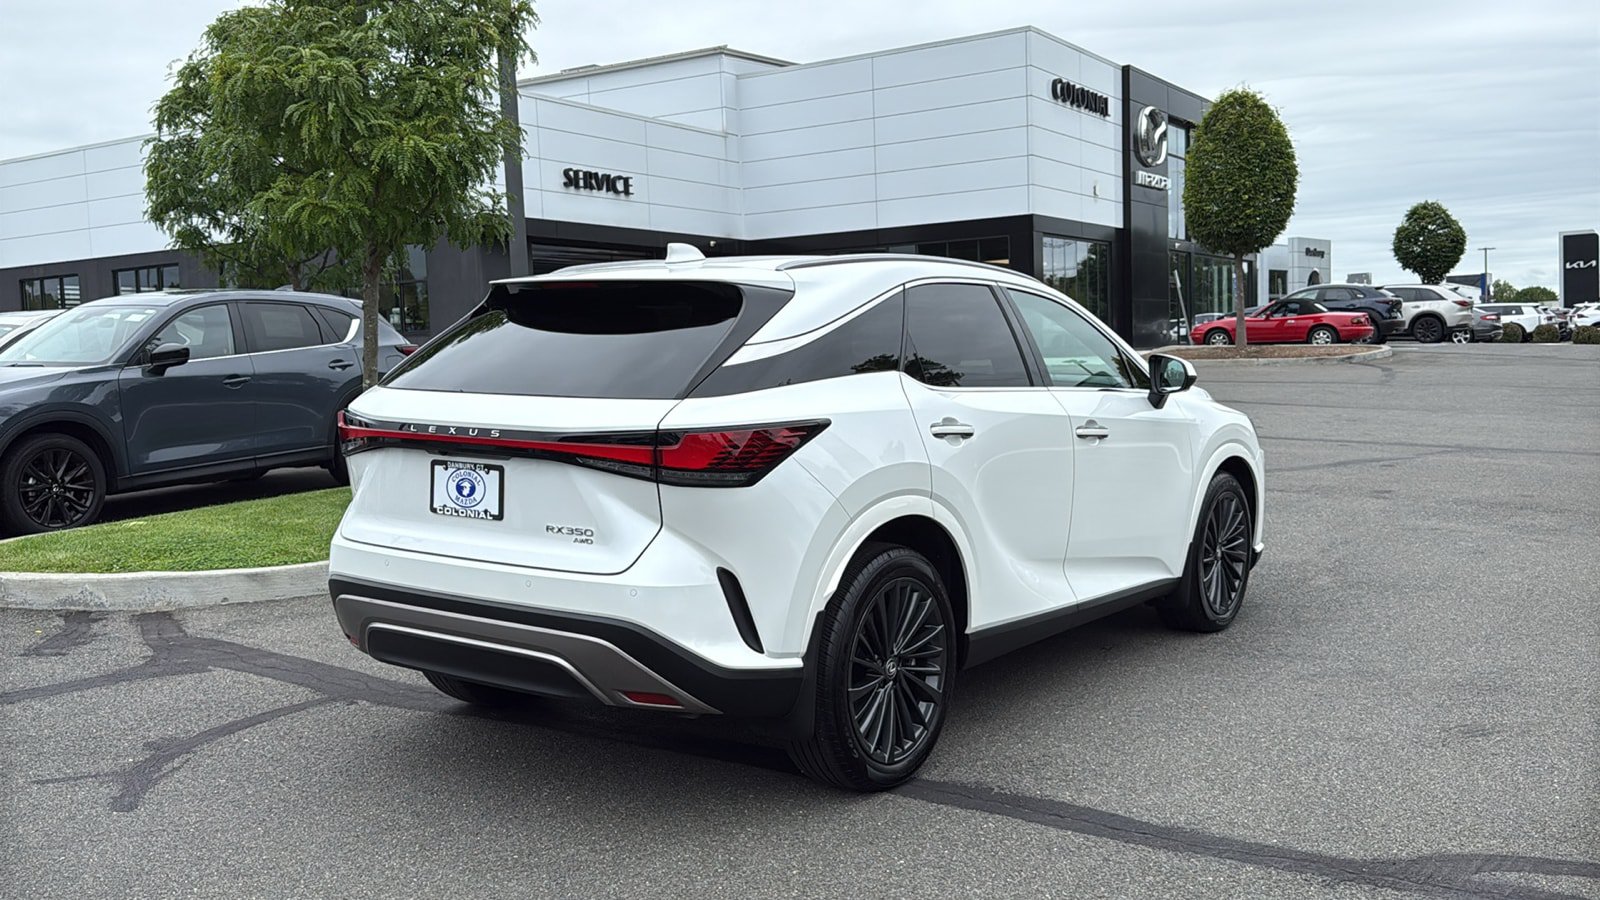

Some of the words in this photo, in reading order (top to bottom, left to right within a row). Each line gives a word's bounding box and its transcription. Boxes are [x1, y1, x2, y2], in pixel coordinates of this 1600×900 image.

[1051, 77, 1111, 118] COLONIAL
[563, 168, 634, 196] SERVICE
[1565, 259, 1597, 269] KIA
[410, 424, 500, 437] LEXUS
[451, 470, 482, 487] COLONIAL
[454, 494, 478, 506] MAZDA
[436, 506, 493, 519] COLONIAL
[572, 537, 594, 545] AWD
